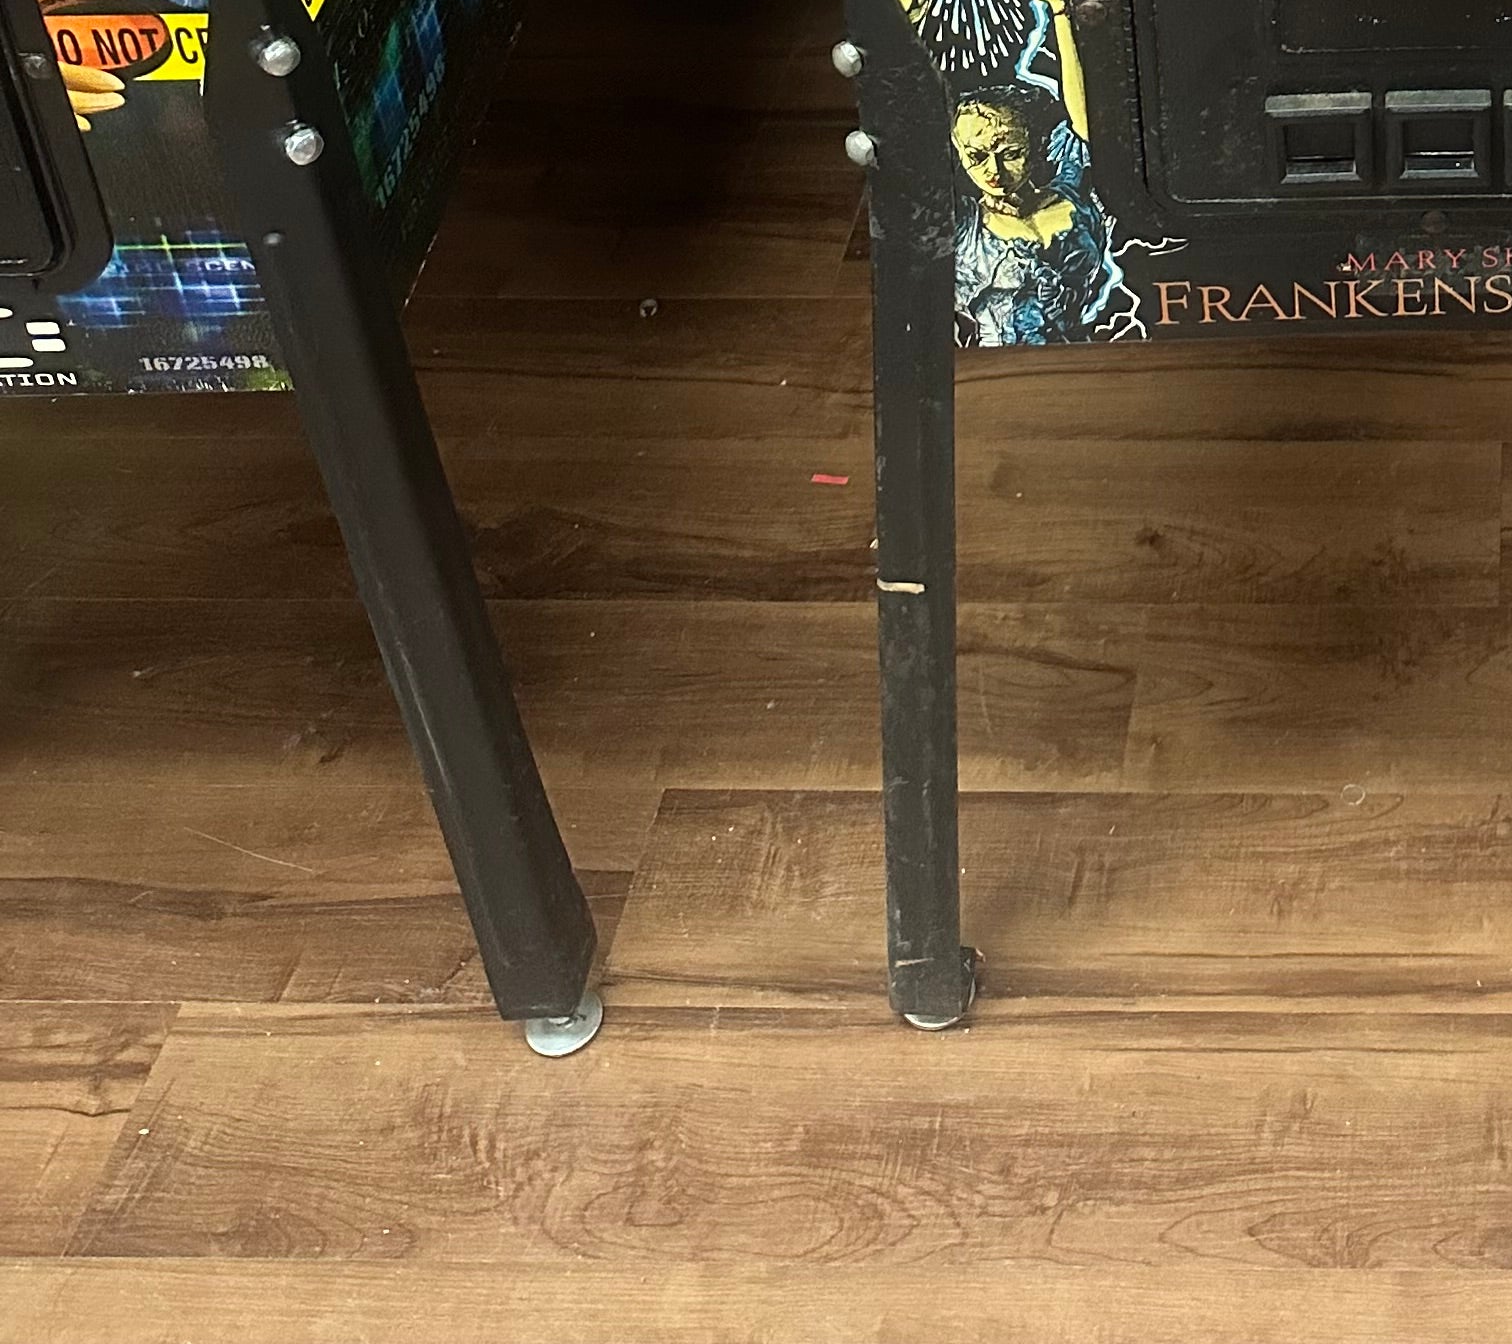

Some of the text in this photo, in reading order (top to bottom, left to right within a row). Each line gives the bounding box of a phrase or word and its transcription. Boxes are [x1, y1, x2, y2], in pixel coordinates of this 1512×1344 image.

[57, 25, 162, 70] O NOT
[1345, 248, 1468, 274] MARY
[138, 354, 269, 372] 16725498
